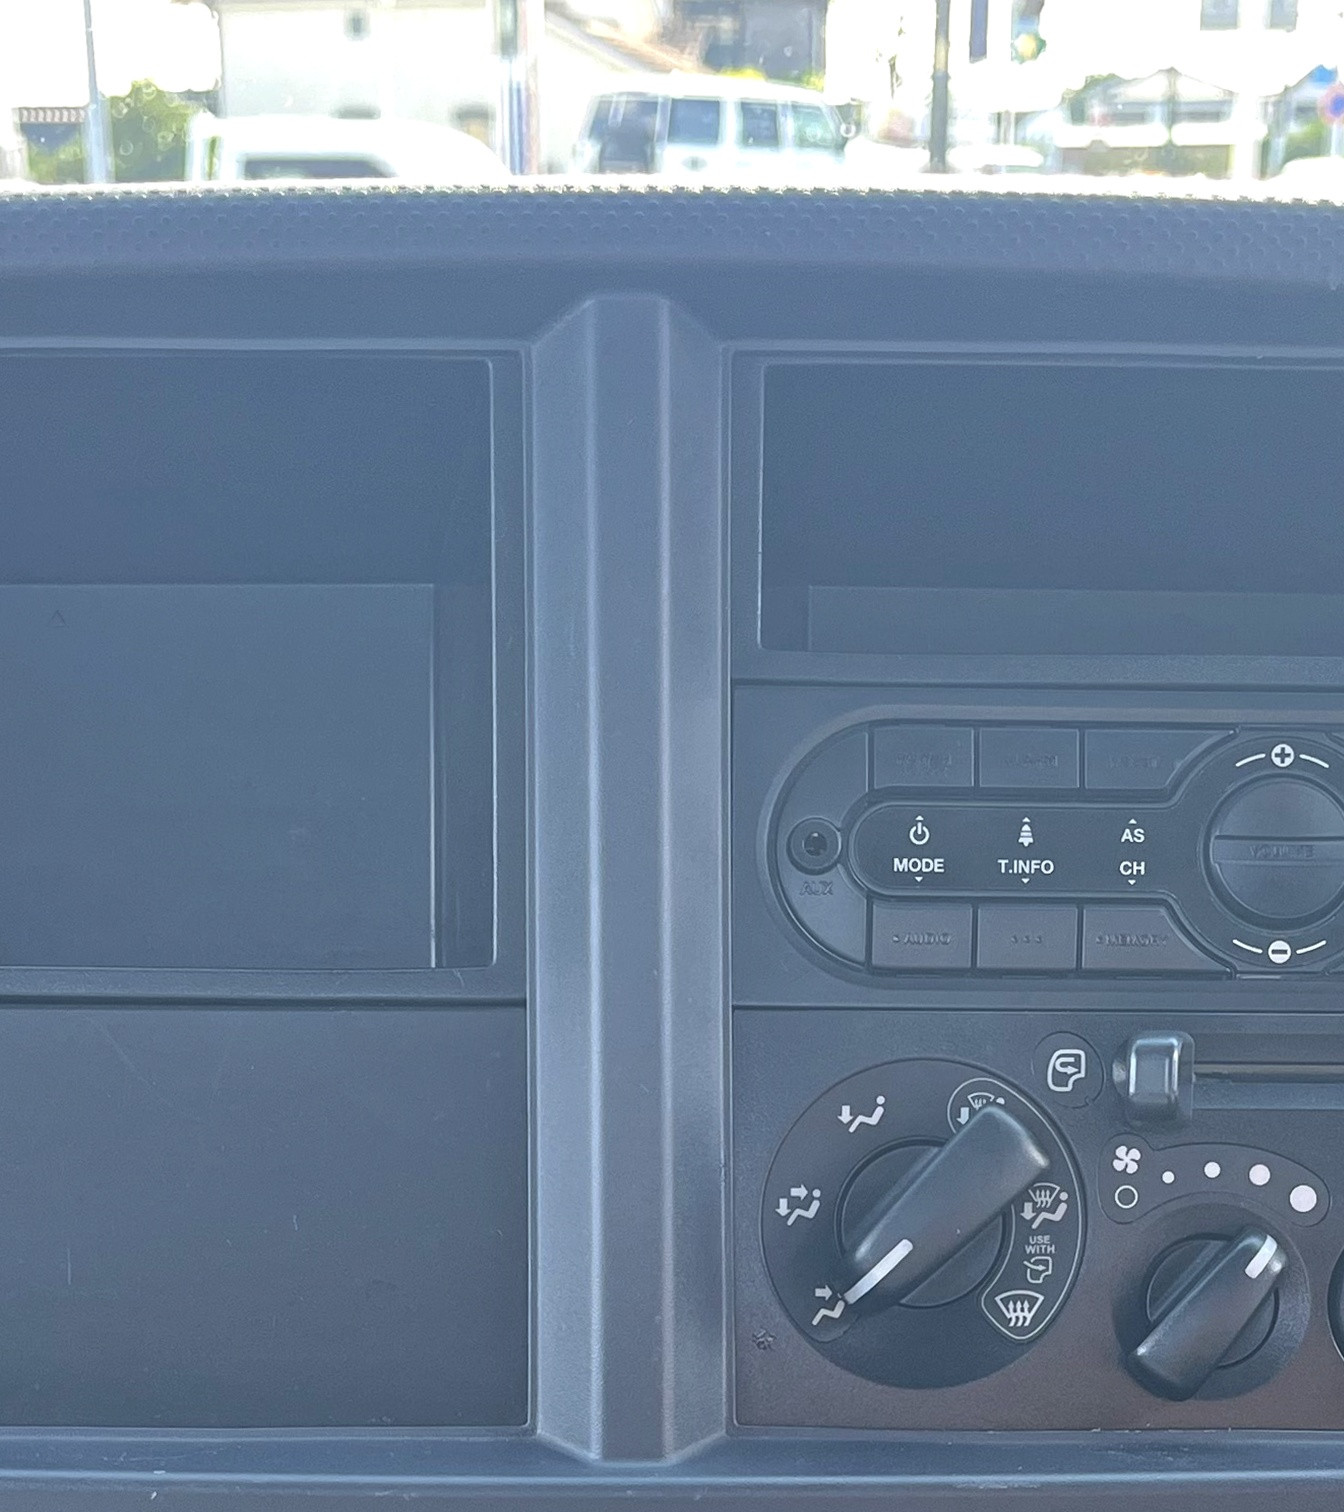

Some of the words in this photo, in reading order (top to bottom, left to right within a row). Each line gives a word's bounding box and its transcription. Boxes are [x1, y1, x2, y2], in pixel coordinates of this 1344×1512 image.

[1120, 828, 1145, 843] AS
[892, 857, 945, 873] MODE
[997, 859, 1055, 874] T.INFO
[1119, 861, 1146, 876] CH
[1029, 1235, 1051, 1244] USE
[1025, 1244, 1055, 1254] WITH
